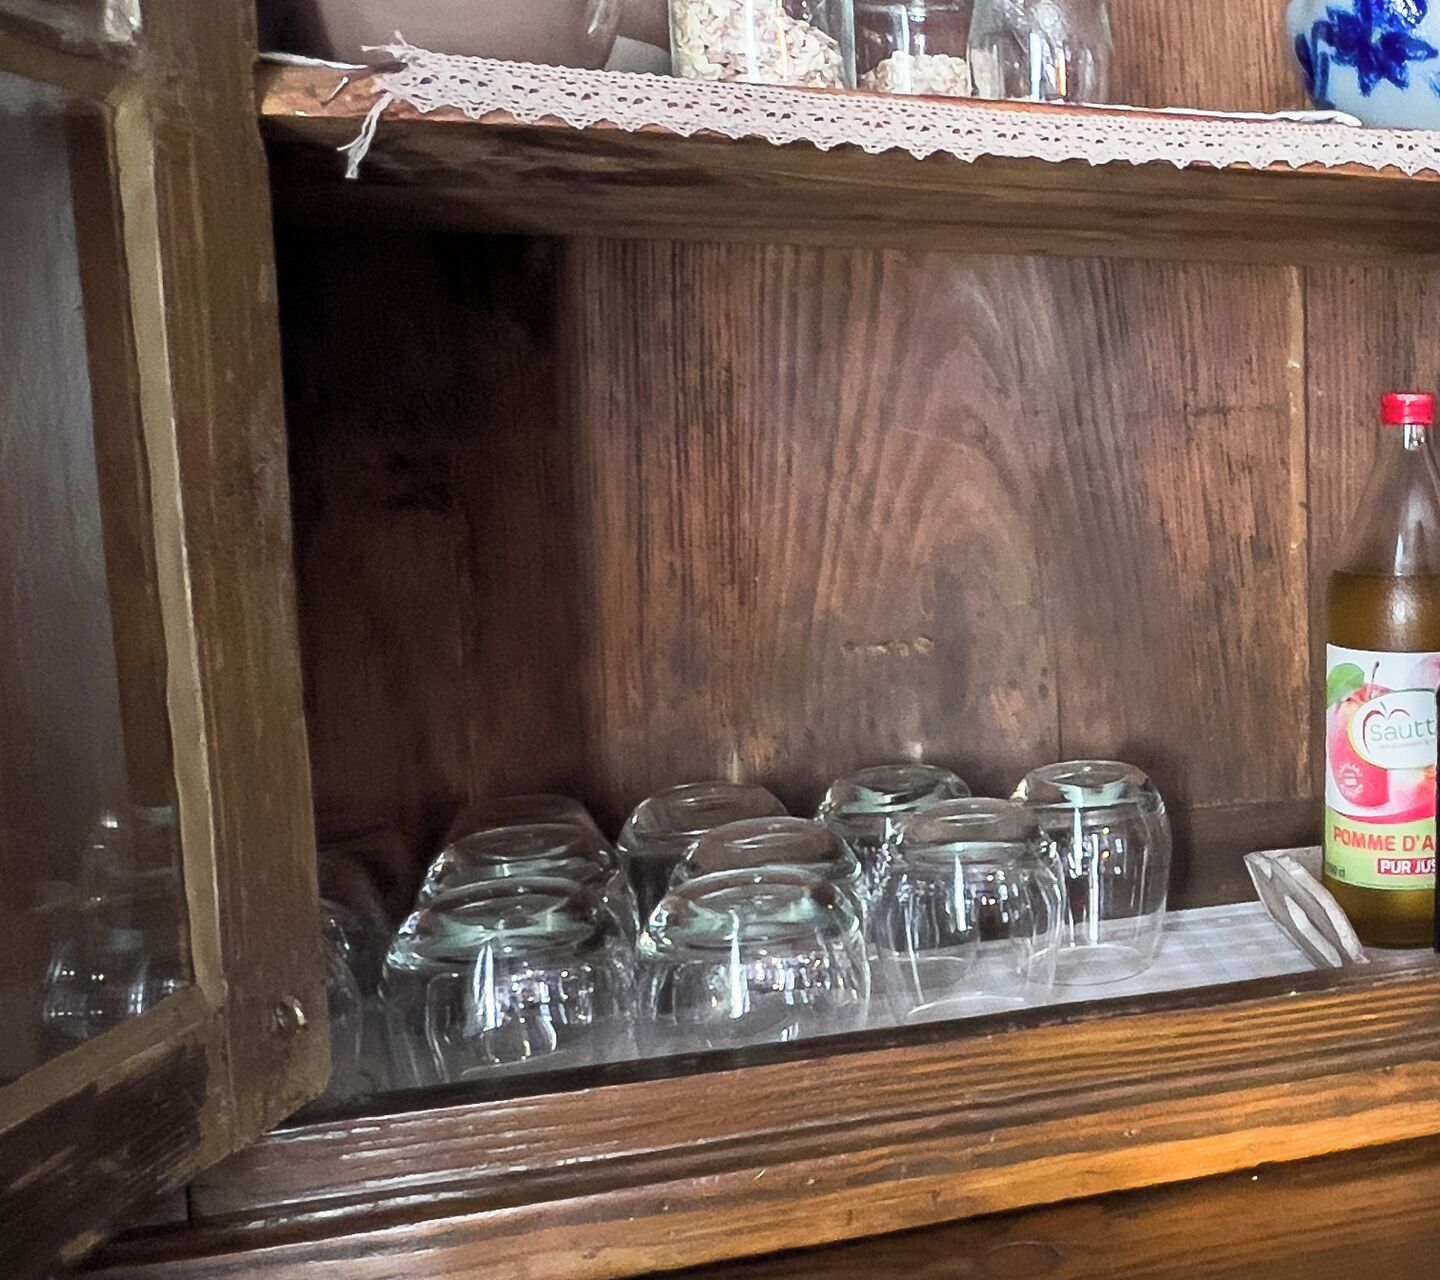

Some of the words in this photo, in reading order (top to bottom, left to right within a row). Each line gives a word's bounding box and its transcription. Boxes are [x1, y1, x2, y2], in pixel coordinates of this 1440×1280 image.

[1369, 719, 1436, 742] Sautt
[1333, 825, 1396, 852] POMME
[1380, 860, 1412, 874] PUR
